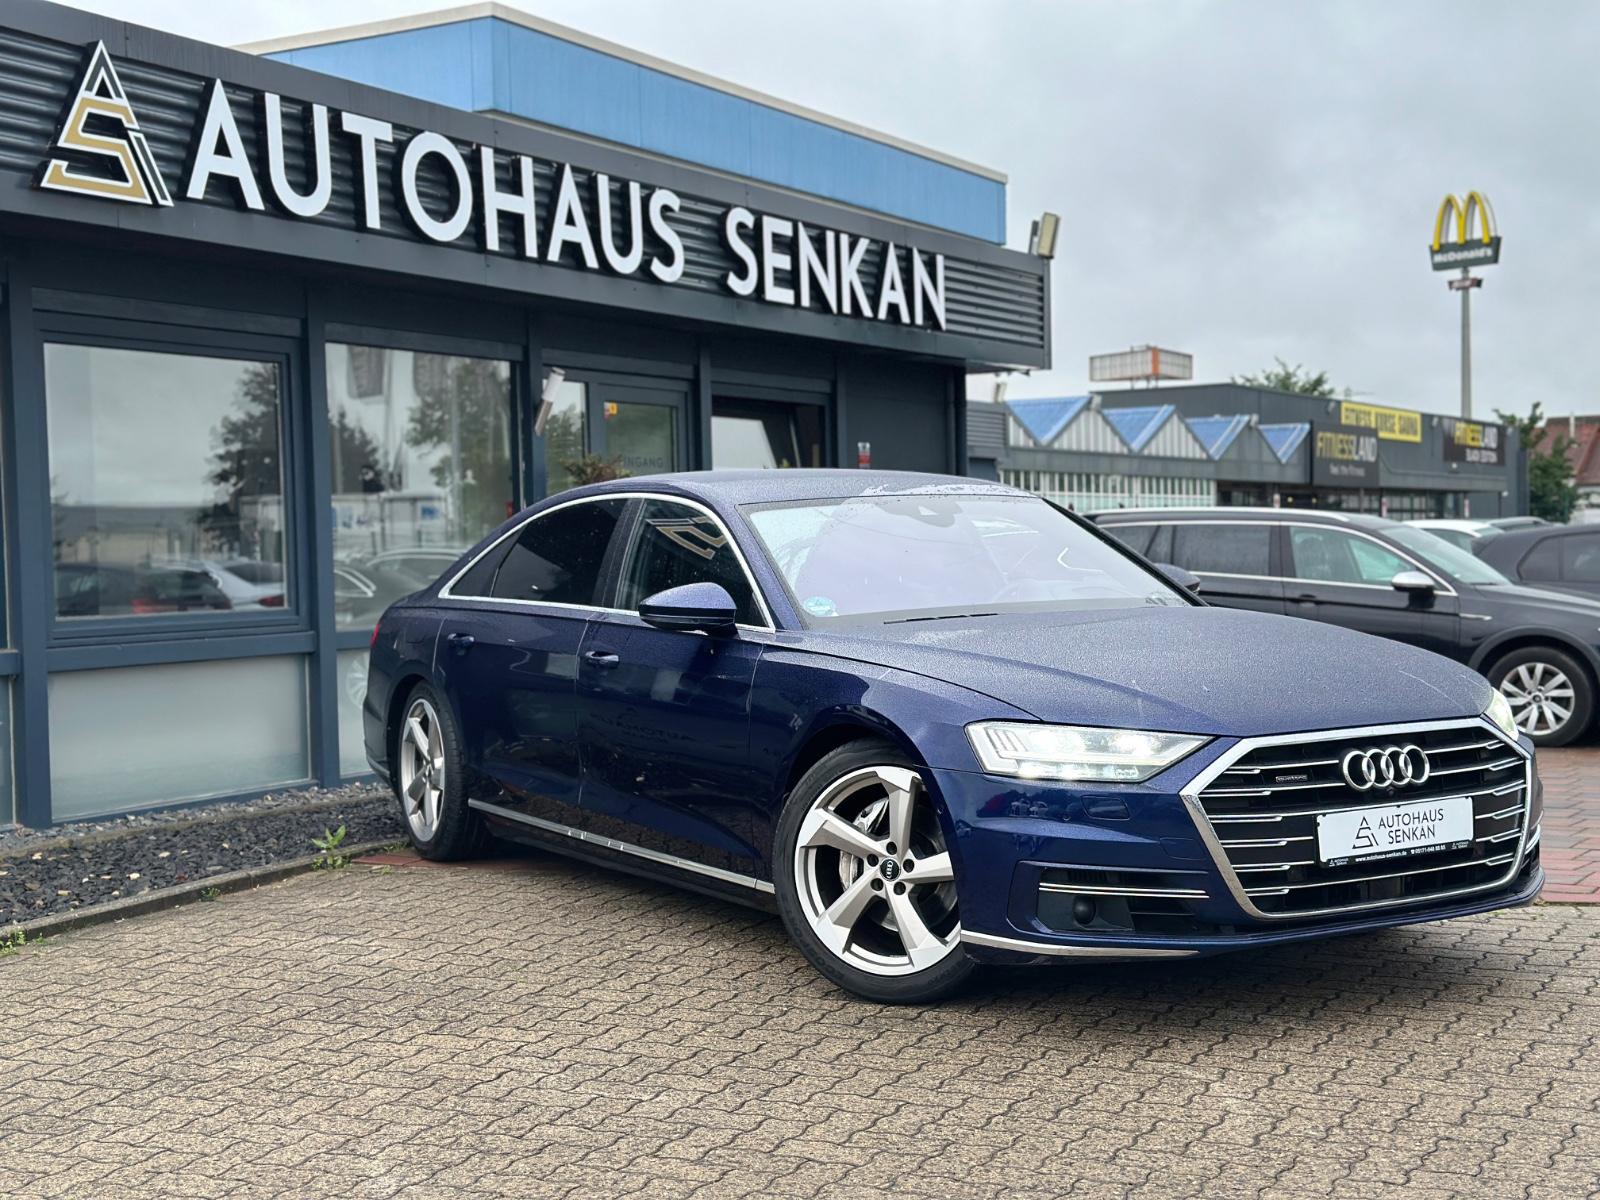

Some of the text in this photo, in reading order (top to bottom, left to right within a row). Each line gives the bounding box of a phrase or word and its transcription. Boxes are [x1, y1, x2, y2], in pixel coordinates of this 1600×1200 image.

[186, 78, 947, 331] AUTOHAUS SENKAN
[1433, 248, 1493, 263] McDonald's
[1317, 432, 1377, 462] FITNESSLAND
[1378, 809, 1444, 830] AUTOHAUS
[1388, 825, 1435, 845] SENKAN
[1355, 850, 1407, 862] www.autohaus-senkan.de
